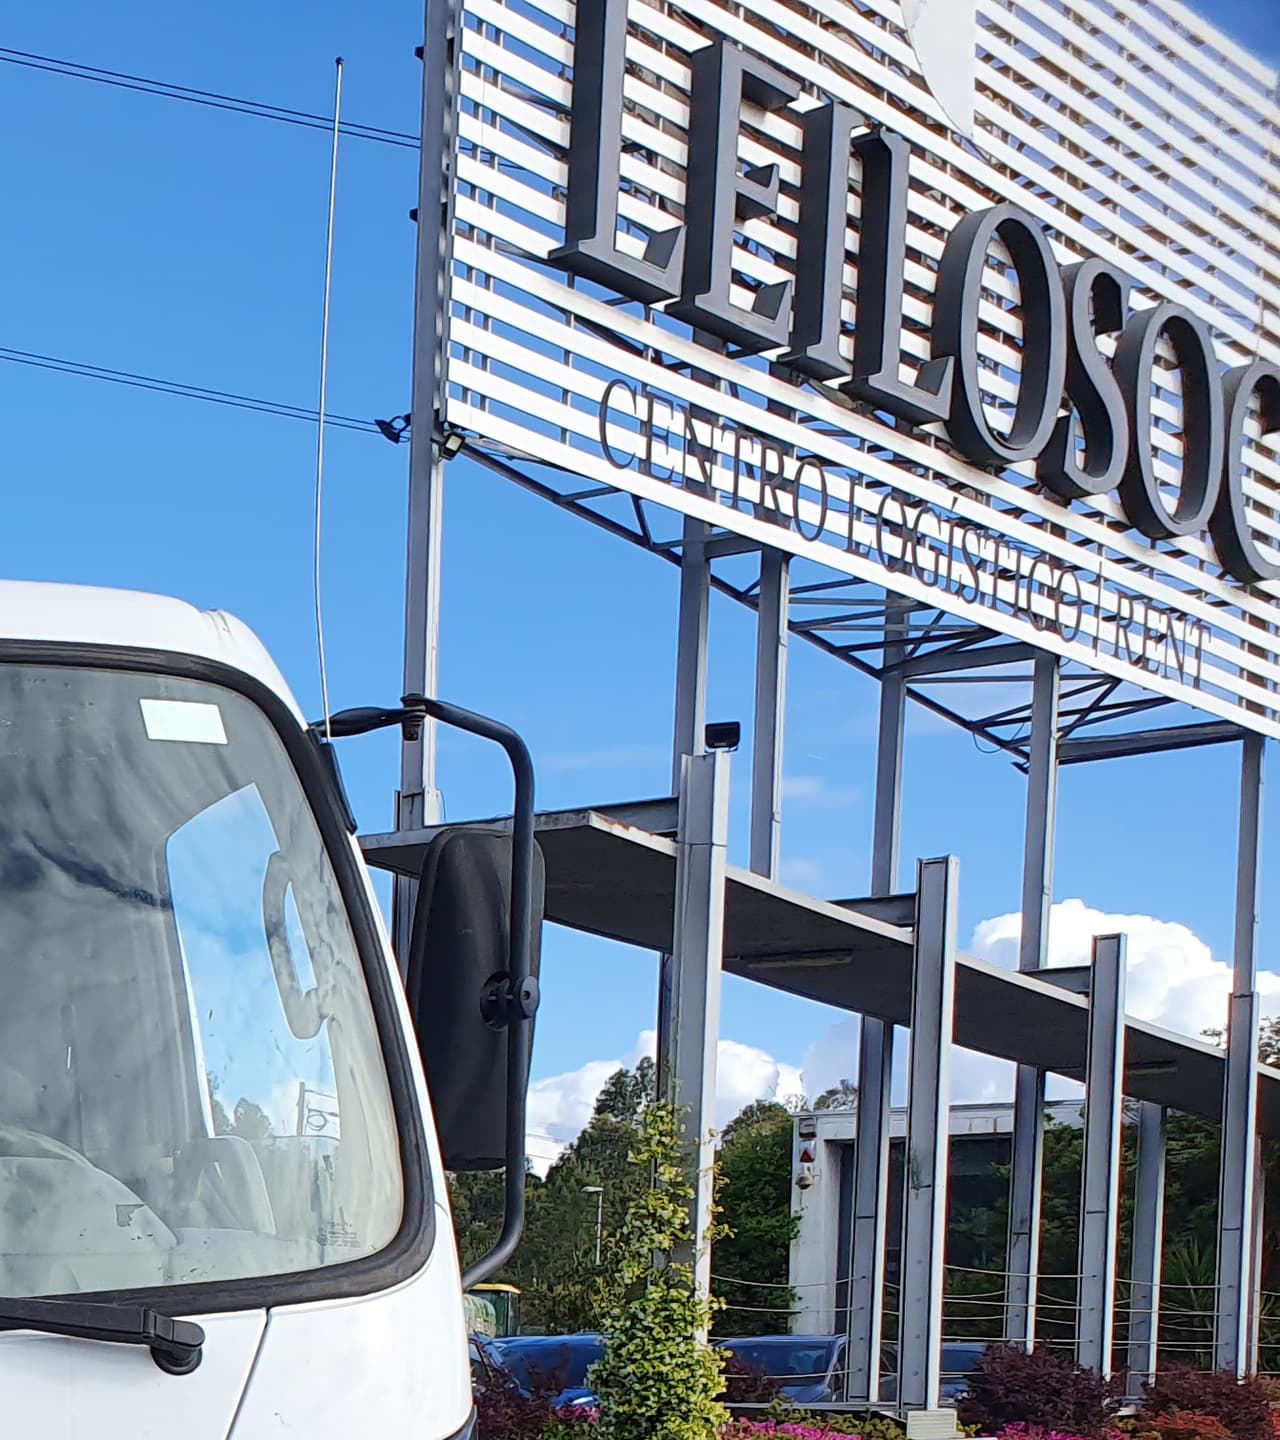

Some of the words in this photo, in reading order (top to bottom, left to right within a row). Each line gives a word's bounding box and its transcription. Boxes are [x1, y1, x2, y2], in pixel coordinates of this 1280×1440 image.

[598, 378, 828, 542] CENTRO
[843, 472, 1082, 644] LOGÍSTICO
[1114, 590, 1212, 690] RENT
